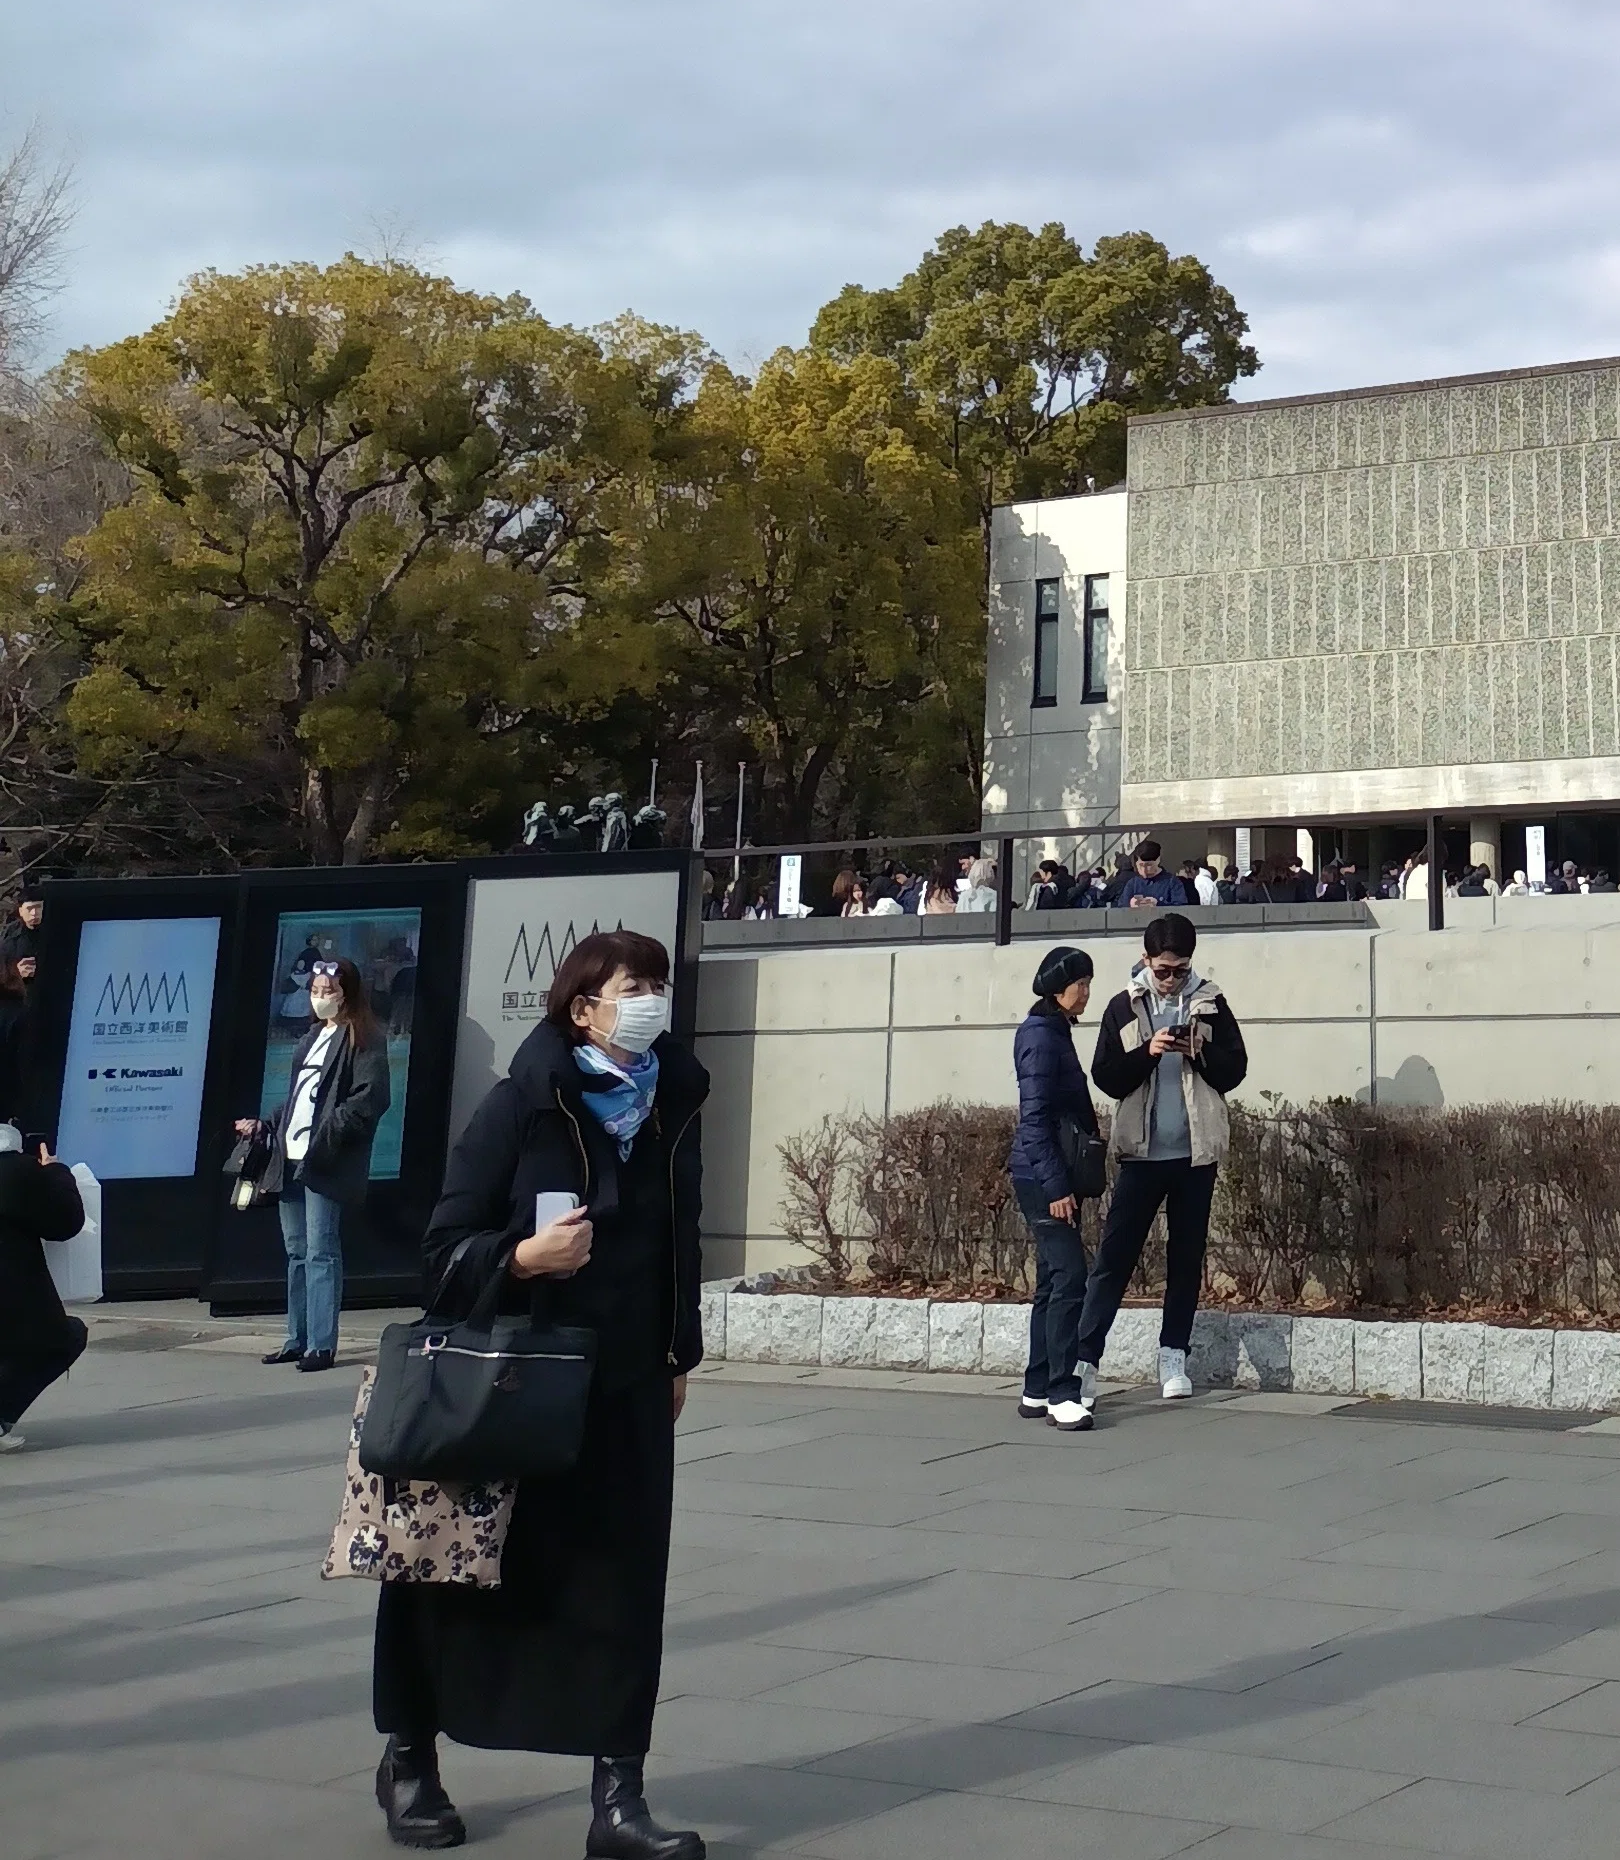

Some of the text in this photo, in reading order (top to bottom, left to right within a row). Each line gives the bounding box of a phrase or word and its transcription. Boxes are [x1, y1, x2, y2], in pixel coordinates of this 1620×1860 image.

[93, 1021, 188, 1035] 国立西洋美術館
[121, 1067, 183, 1078] Kawasaki
